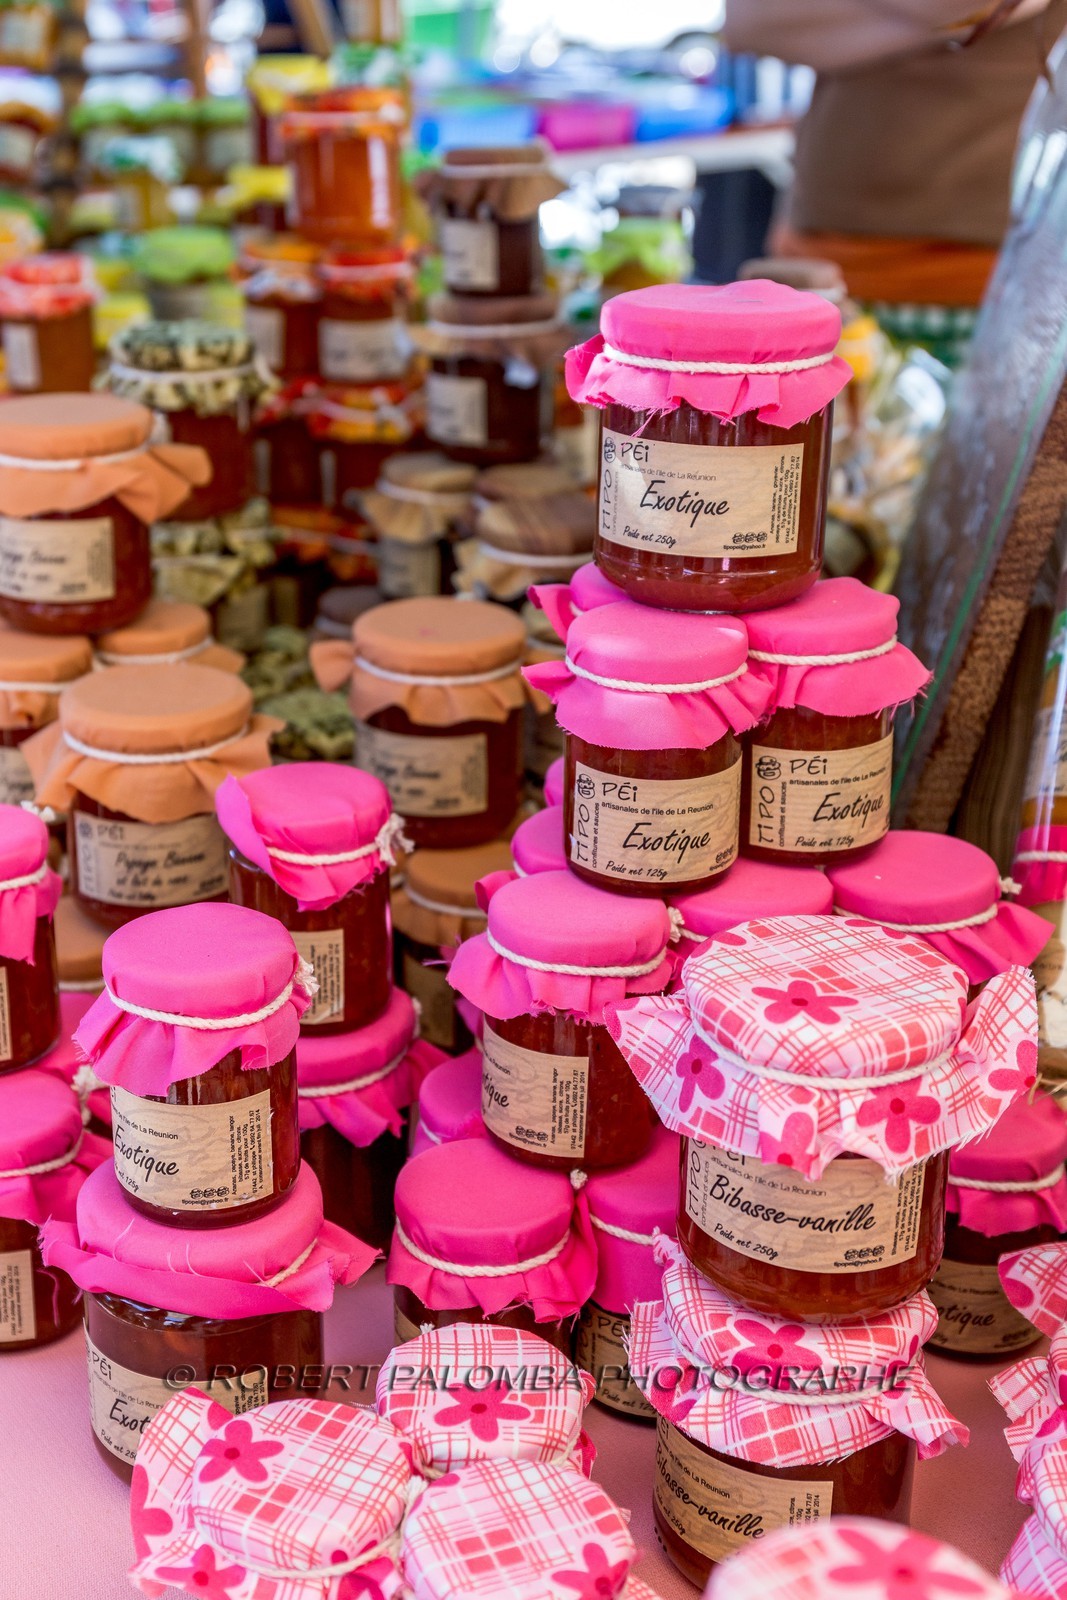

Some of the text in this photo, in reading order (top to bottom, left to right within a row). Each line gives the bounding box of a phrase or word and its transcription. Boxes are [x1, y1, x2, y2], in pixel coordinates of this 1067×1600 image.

[640, 480, 730, 528] Exotique
[622, 525, 677, 549] Poids net 250g
[789, 756, 828, 775] PÉi
[852, 775, 861, 783] de
[861, 773, 870, 781] La
[602, 782, 638, 802] PÉi
[601, 801, 639, 814] artisanales
[780, 806, 786, 814] et
[813, 792, 884, 829] Exotique
[593, 827, 599, 836] et
[622, 822, 711, 864] Exotique
[795, 835, 855, 848] Poids net 125g
[606, 861, 668, 881] Poids net 125g
[483, 1074, 509, 1108] tique
[131, 1121, 139, 1131] de
[139, 1124, 147, 1133] La
[148, 1129, 179, 1140] Reunion
[114, 1124, 180, 1182] Exotique
[125, 1176, 139, 1193] 125g
[744, 1173, 754, 1182] de
[767, 1181, 778, 1190] de
[780, 1183, 790, 1191] La
[710, 1174, 877, 1233] Bibasse-vanille
[714, 1222, 778, 1260] Poids net 250g
[937, 1304, 996, 1335] otique
[110, 1398, 150, 1434] Exot
[656, 1440, 767, 1540] Bibasse-vanille
[691, 1471, 700, 1484] La
[700, 1478, 731, 1499] Reunion
